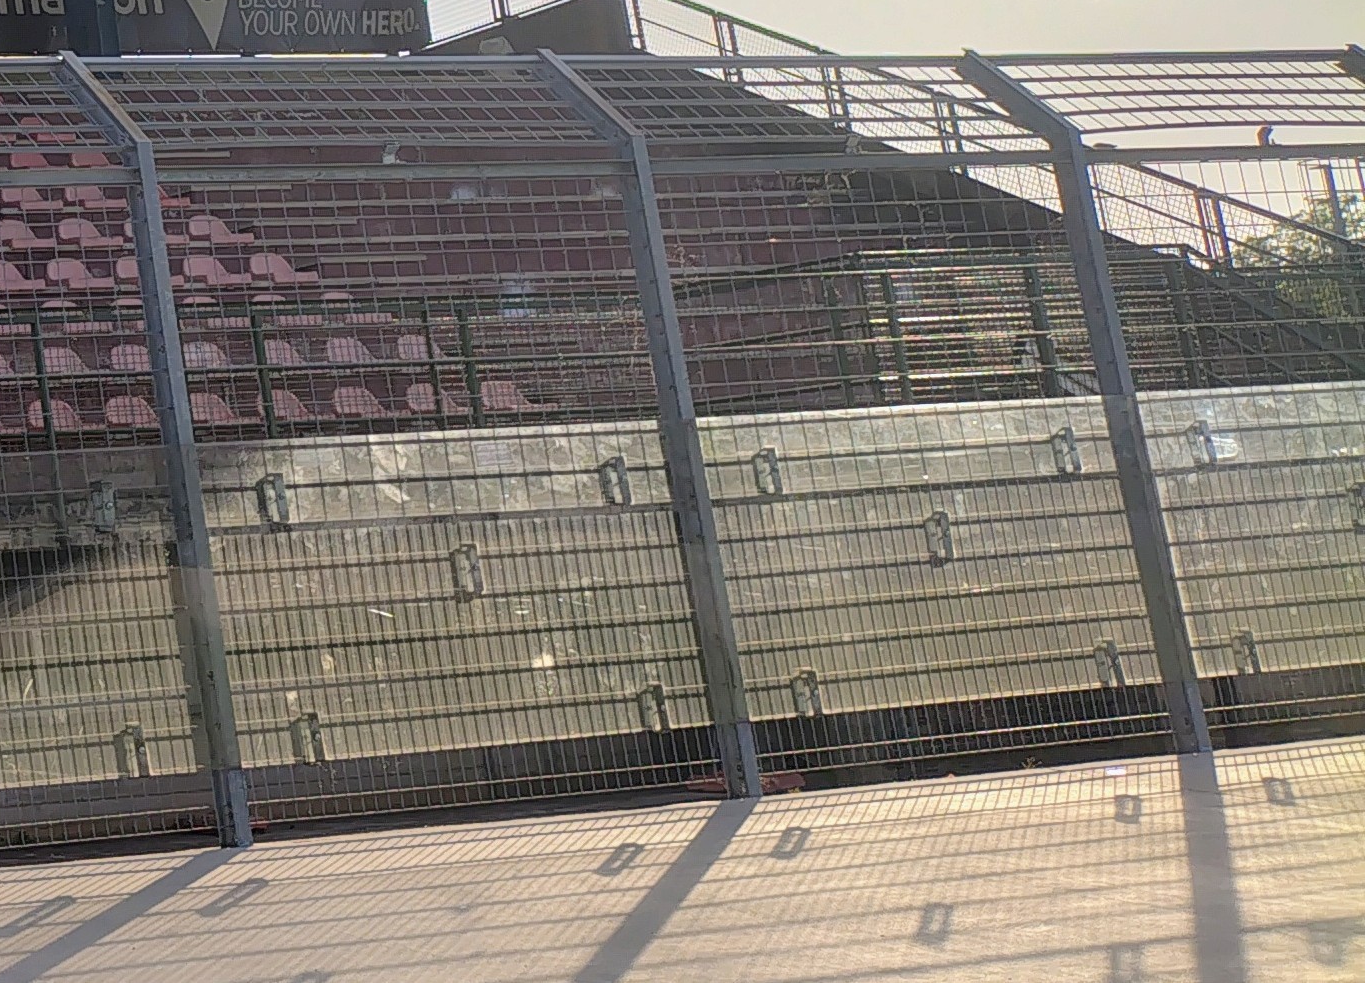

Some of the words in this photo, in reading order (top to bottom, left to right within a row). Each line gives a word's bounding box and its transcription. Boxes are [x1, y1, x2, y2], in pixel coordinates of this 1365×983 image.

[240, 10, 298, 36] YOUR
[304, 9, 355, 36] OWN
[362, 6, 420, 36] HERO.
